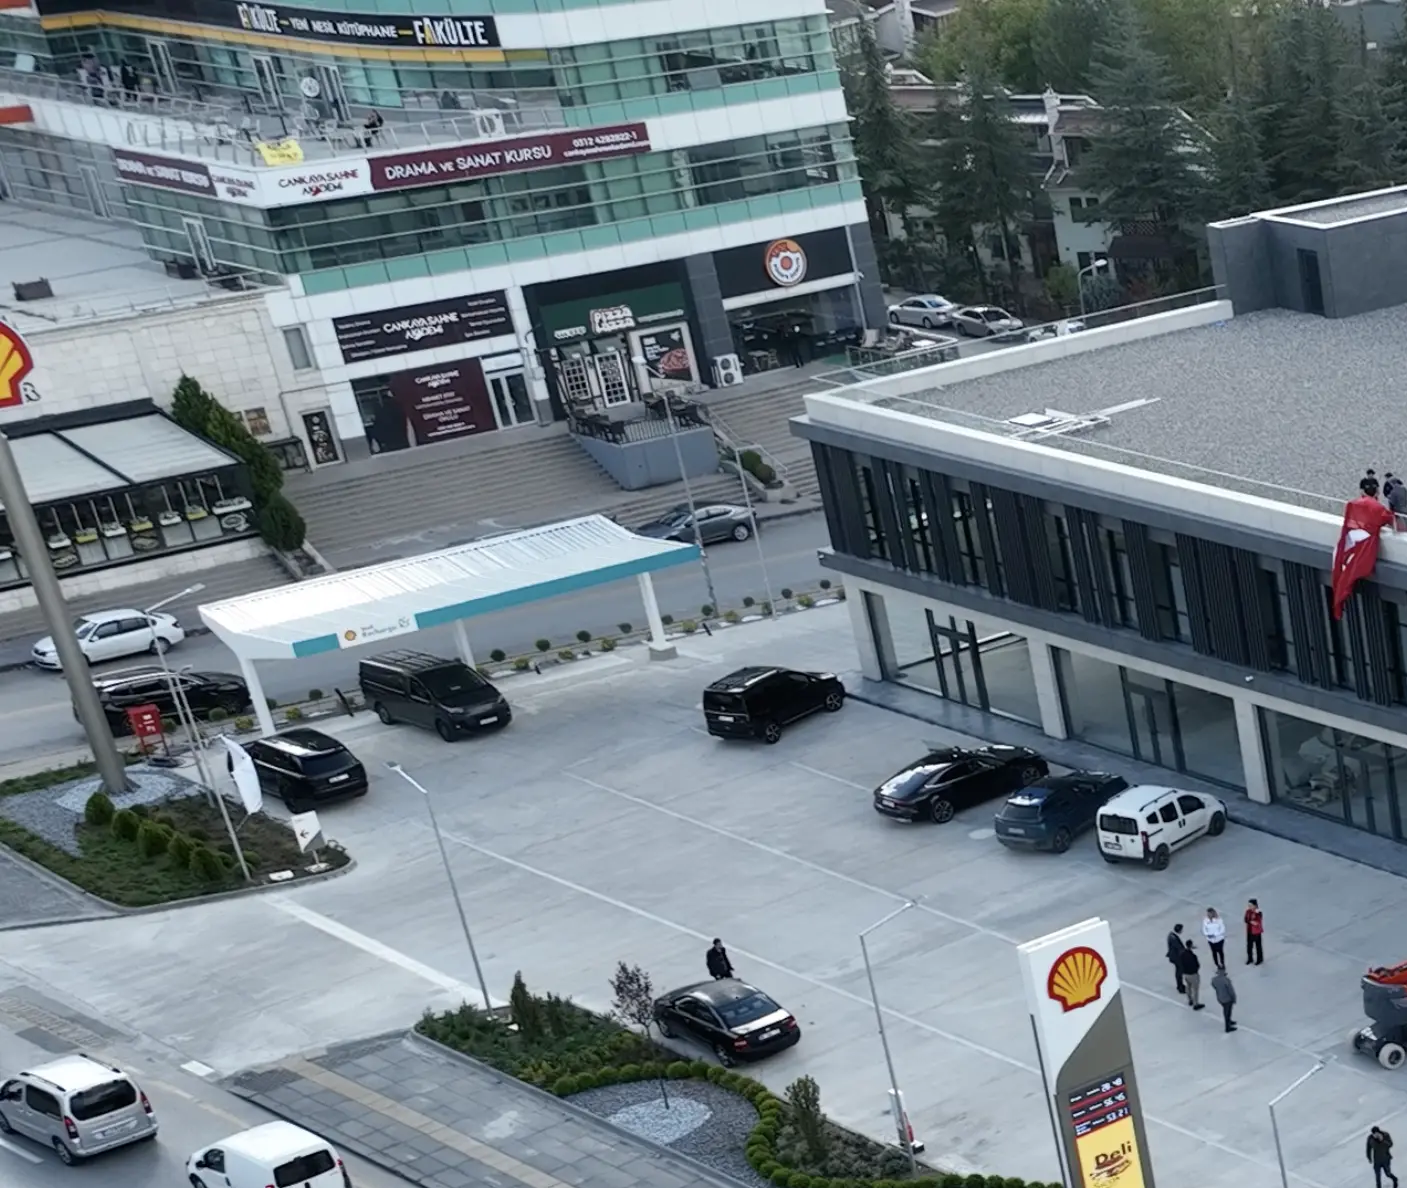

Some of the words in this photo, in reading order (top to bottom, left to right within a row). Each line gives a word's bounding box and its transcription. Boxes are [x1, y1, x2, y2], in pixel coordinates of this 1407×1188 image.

[412, 17, 489, 45] FAKÜLTE
[384, 159, 438, 181] DRAMA
[456, 152, 501, 171] SANAT
[504, 145, 553, 164] KURSU
[1095, 1140, 1132, 1165] Deli
